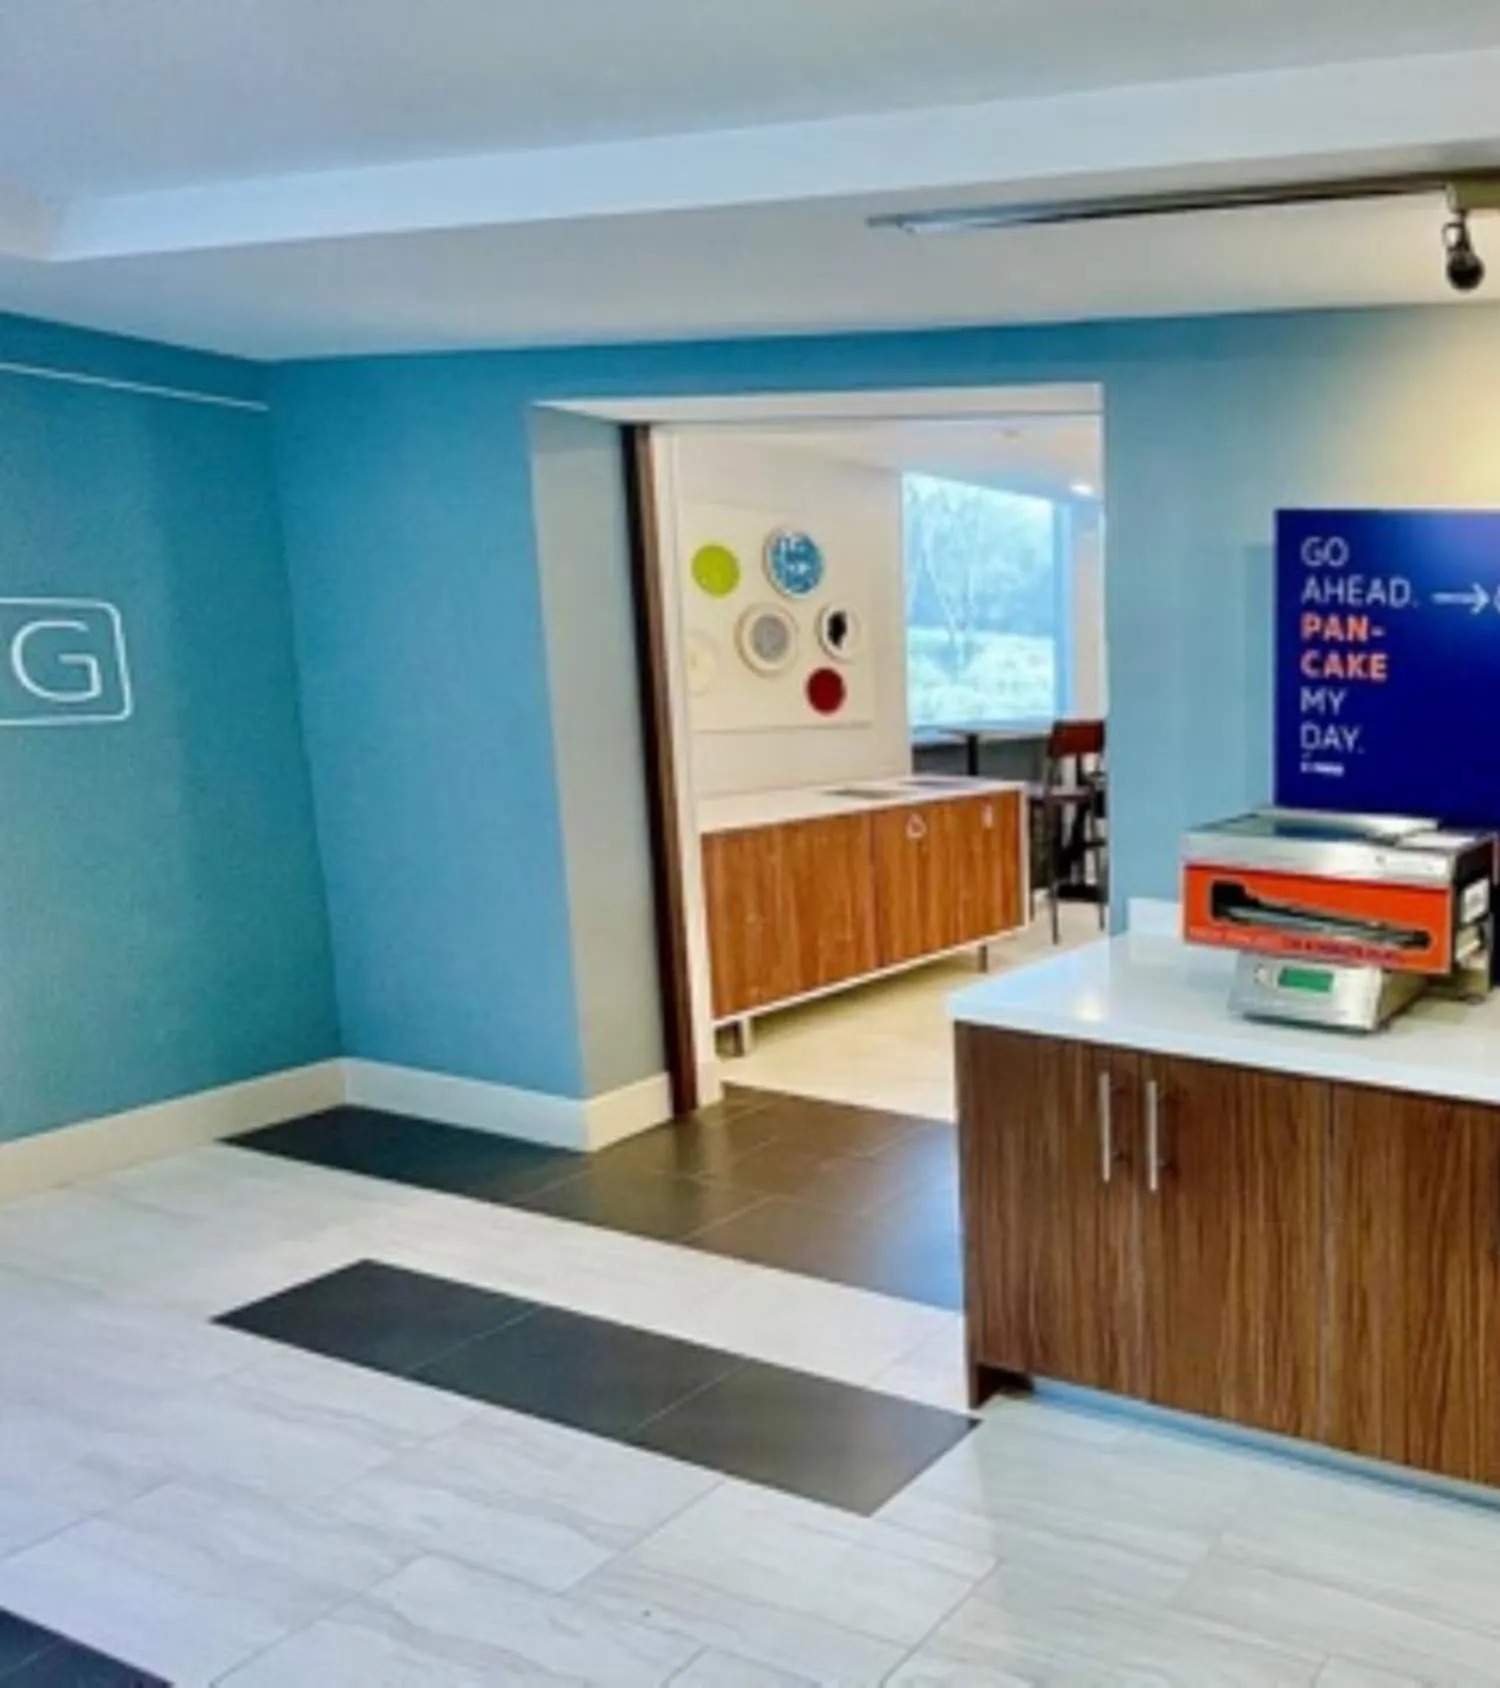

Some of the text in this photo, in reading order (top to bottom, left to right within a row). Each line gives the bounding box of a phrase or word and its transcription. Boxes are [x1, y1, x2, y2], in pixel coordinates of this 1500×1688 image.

[1301, 536, 1349, 567] GO
[1301, 575, 1418, 608] AHEAD.
[1301, 612, 1384, 641] PAN-
[12, 620, 101, 701] G
[1301, 650, 1387, 681] CAKE
[1301, 687, 1346, 715] MY
[1301, 722, 1364, 754] DAY.
